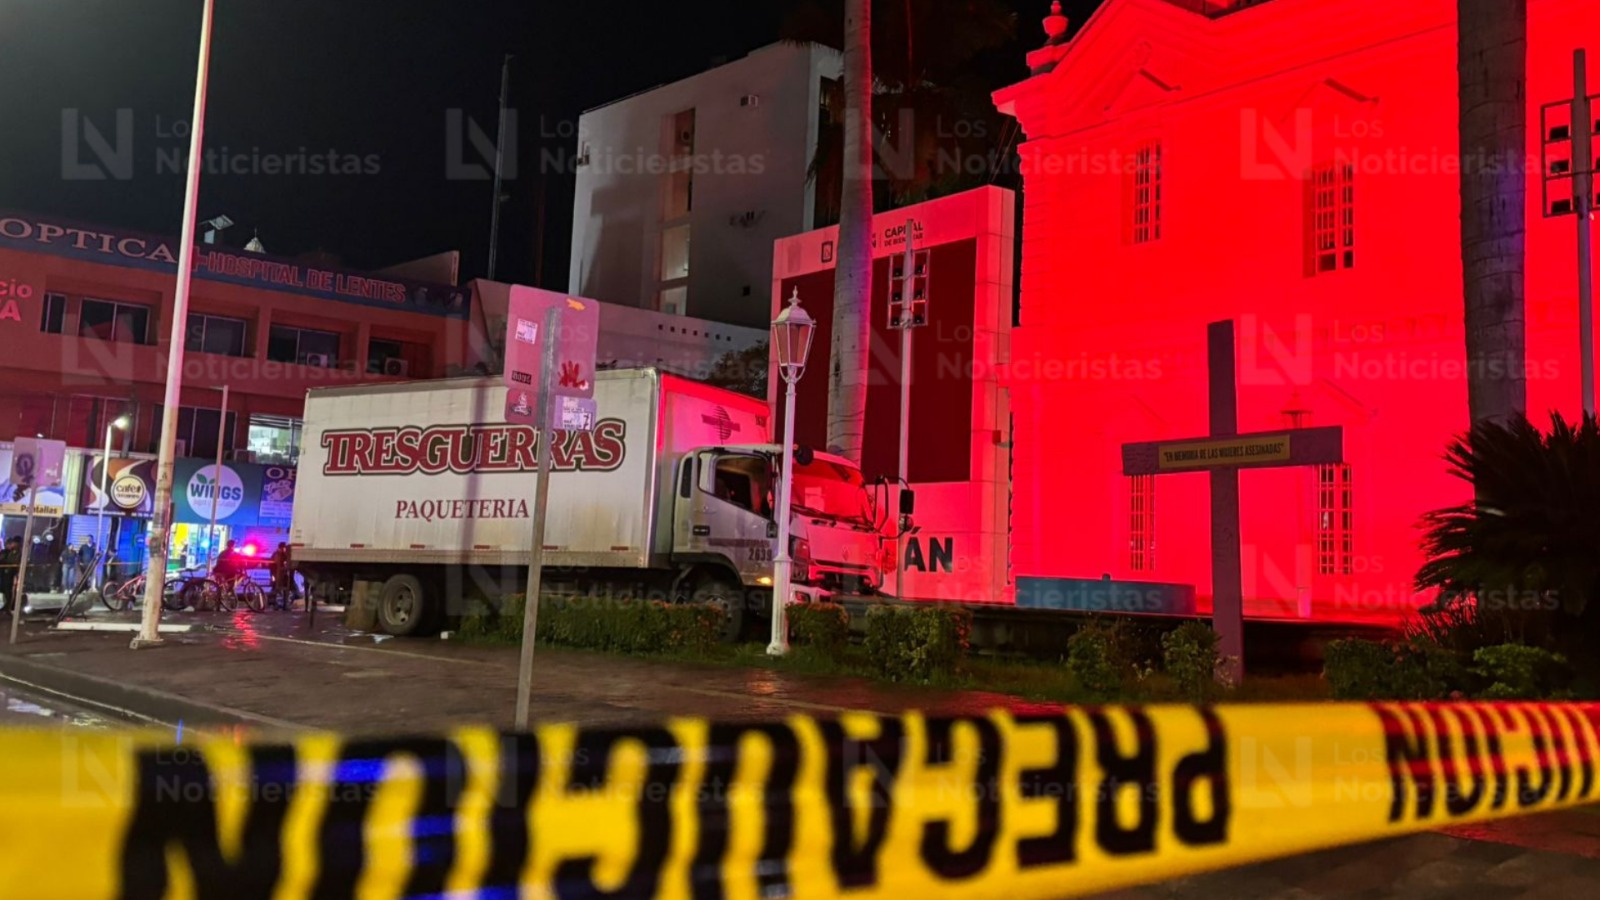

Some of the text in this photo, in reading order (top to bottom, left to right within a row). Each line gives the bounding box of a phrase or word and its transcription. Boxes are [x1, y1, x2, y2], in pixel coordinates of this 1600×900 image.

[0, 217, 178, 264] OPTICA
[885, 221, 923, 238] CAPIAL
[208, 251, 406, 303] HOSPITAL DE LENTES
[321, 418, 627, 476] TRESGUERRAS
[20, 504, 58, 515] Patallas
[395, 498, 530, 522] PAQUETERIA
[748, 548, 773, 561] 2639
[904, 526, 953, 573] ÁN
[114, 703, 1231, 900] PRECAUCION
